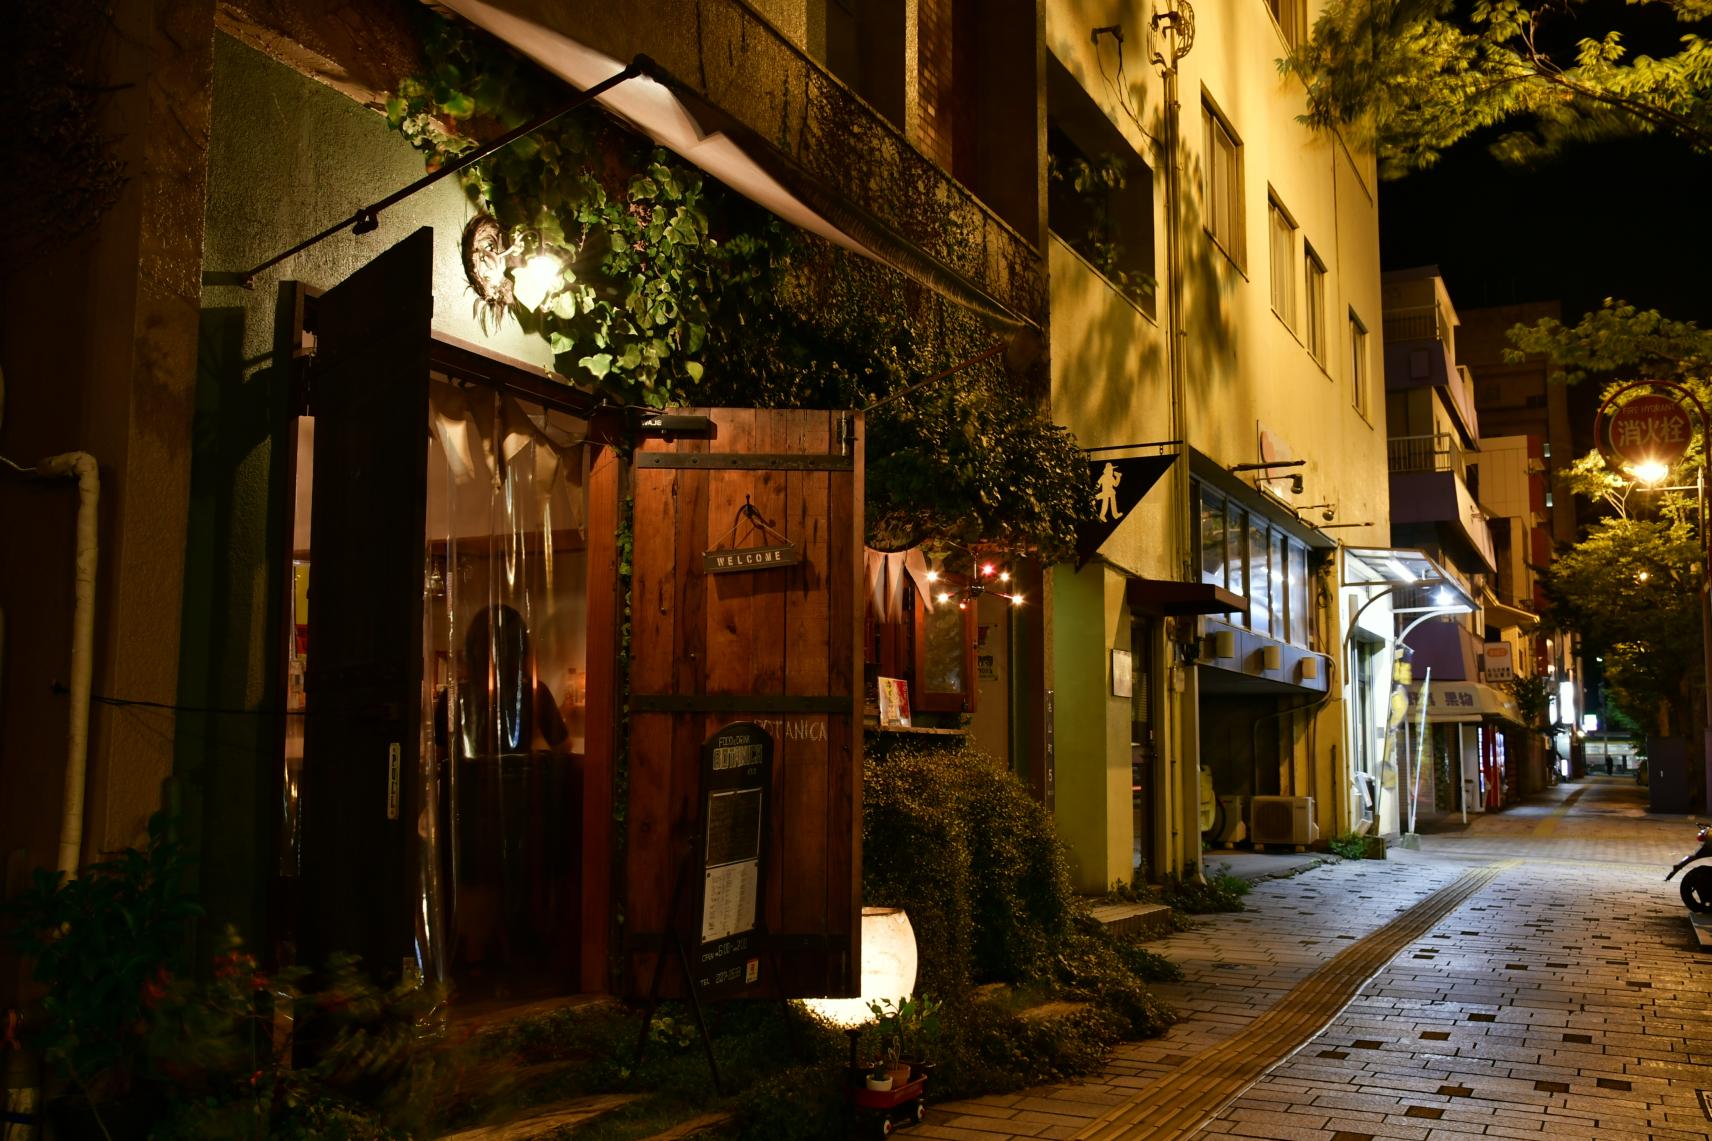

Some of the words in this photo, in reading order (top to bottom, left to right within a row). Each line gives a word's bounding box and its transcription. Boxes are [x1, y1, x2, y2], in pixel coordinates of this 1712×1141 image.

[1617, 415, 1685, 447] 消火栓
[716, 551, 781, 567] WELCOME
